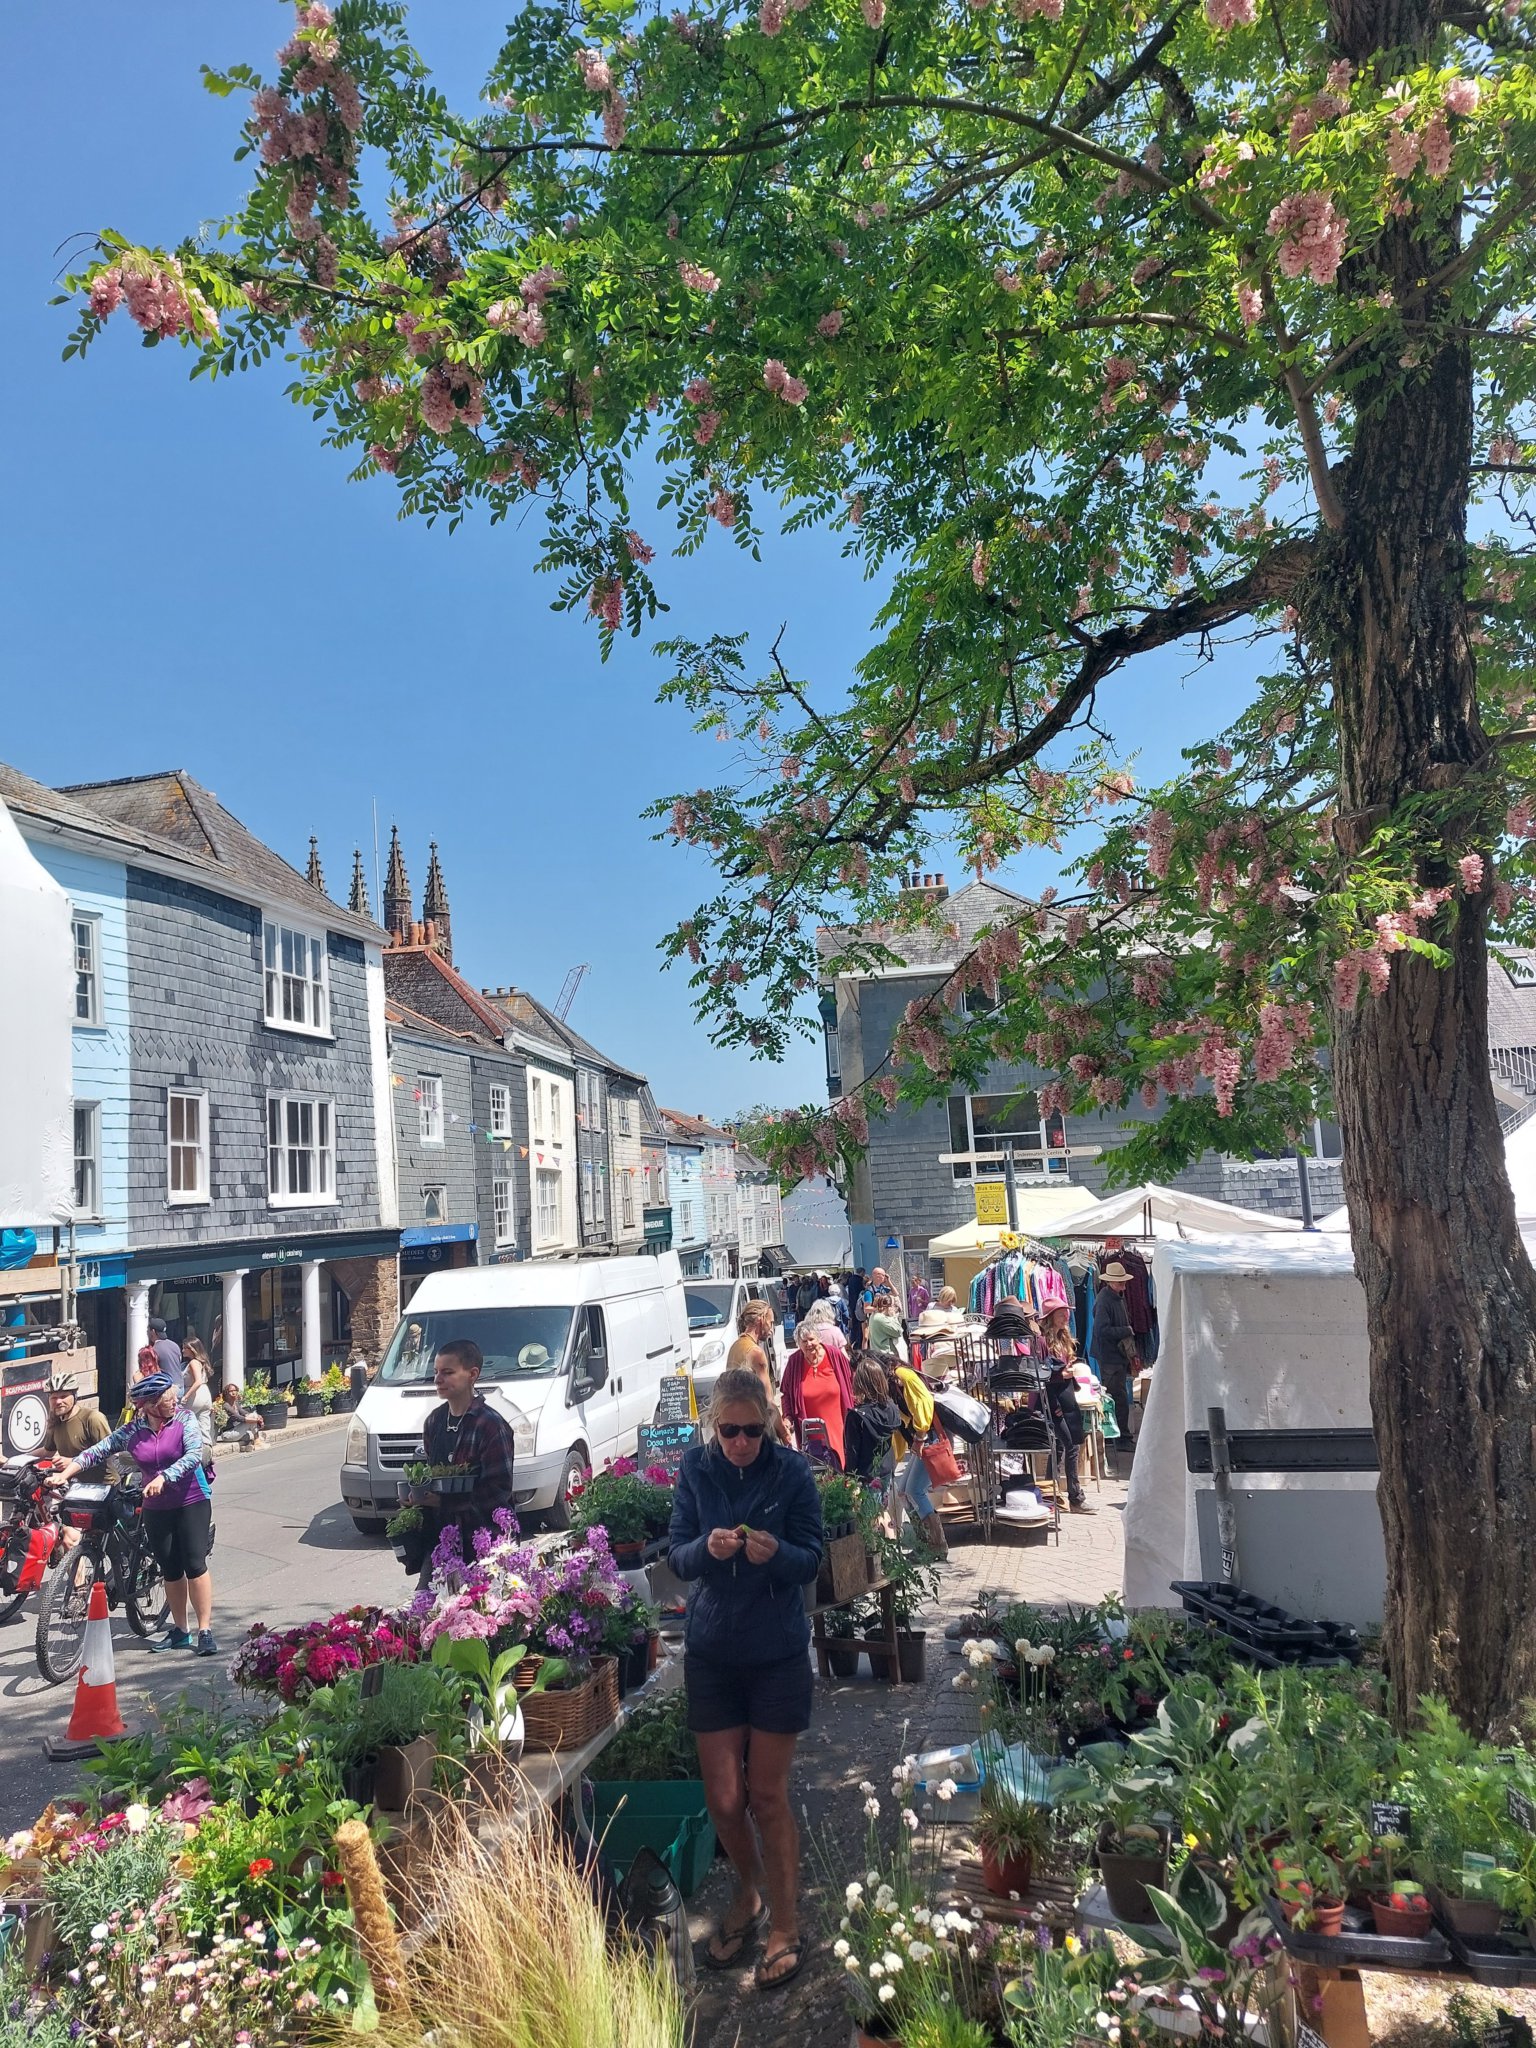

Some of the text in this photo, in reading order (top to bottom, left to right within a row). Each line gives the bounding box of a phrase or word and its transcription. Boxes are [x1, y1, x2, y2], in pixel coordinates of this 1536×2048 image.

[261, 1252, 277, 1260] eleven
[286, 1249, 303, 1258] clothing
[5, 1381, 42, 1396] SCAFFOLDING
[650, 1427, 675, 1438] Kumar's
[646, 1436, 679, 1447] Dosa Bar
[1373, 1810, 1400, 1823] Tomato
